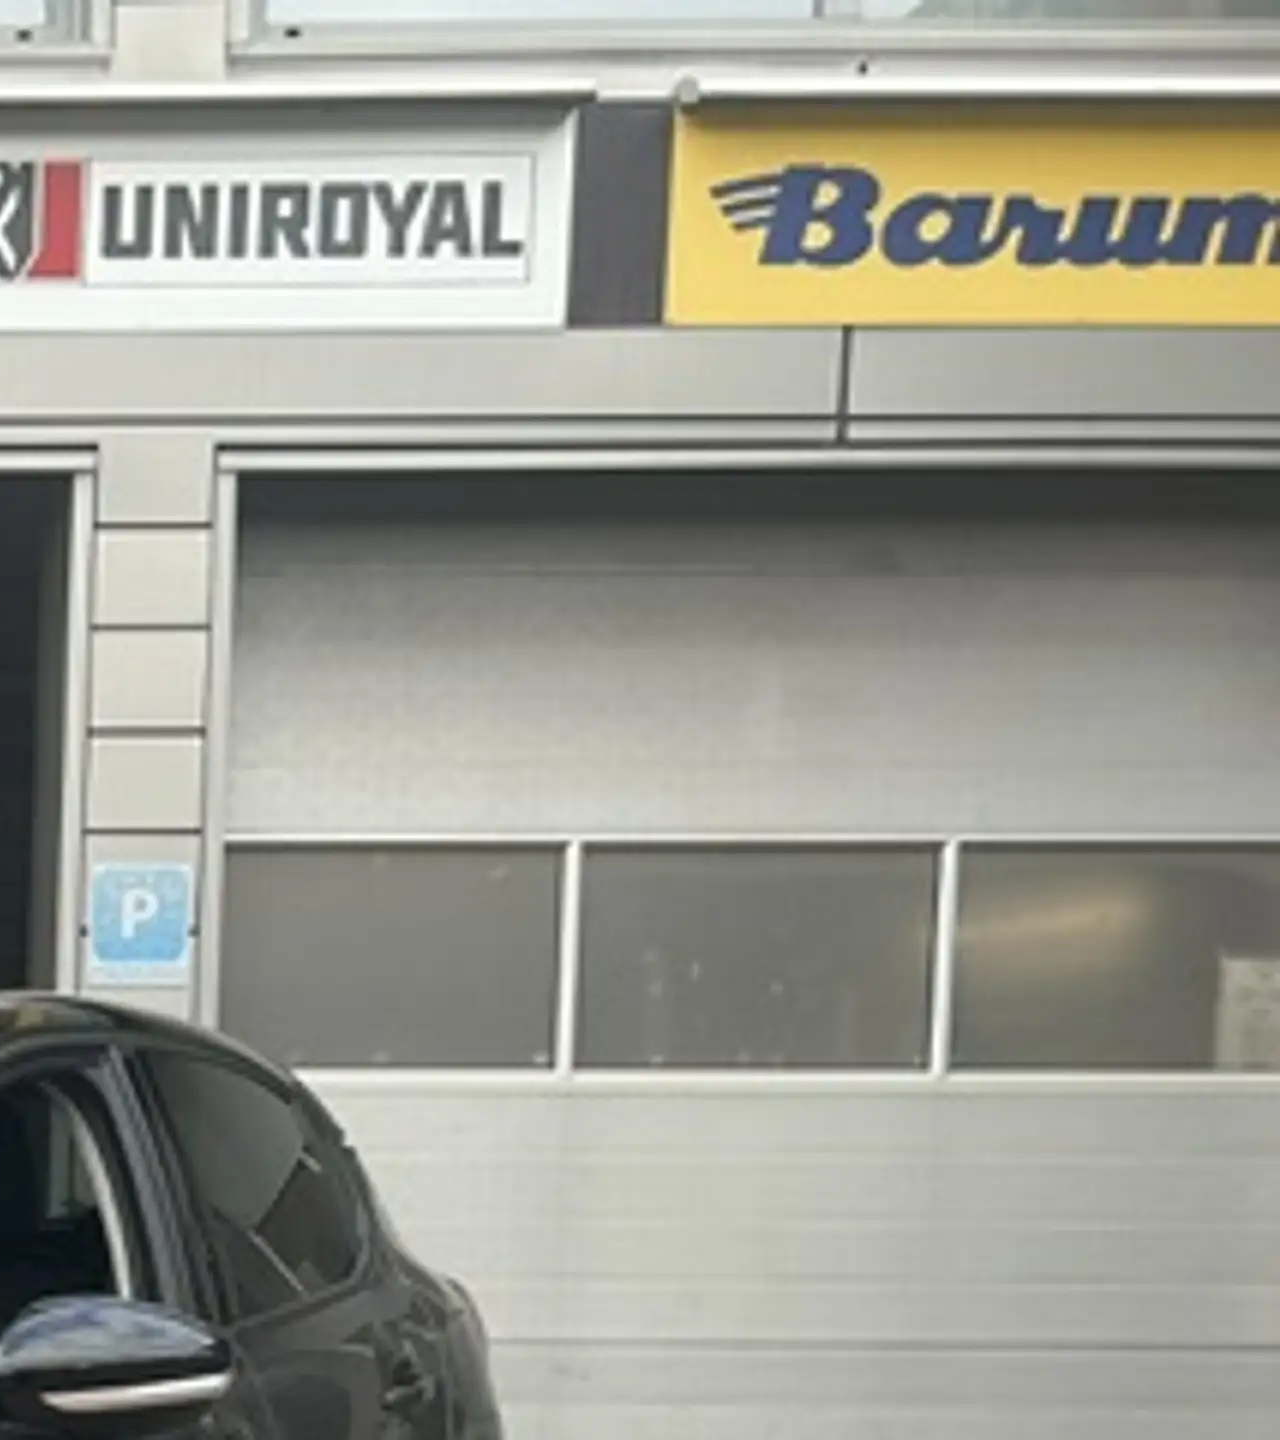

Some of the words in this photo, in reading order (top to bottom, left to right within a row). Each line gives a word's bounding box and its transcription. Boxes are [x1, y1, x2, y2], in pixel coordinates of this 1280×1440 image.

[99, 180, 525, 260] UNIROYAL
[758, 163, 1280, 267] Barum
[121, 887, 160, 940] P
